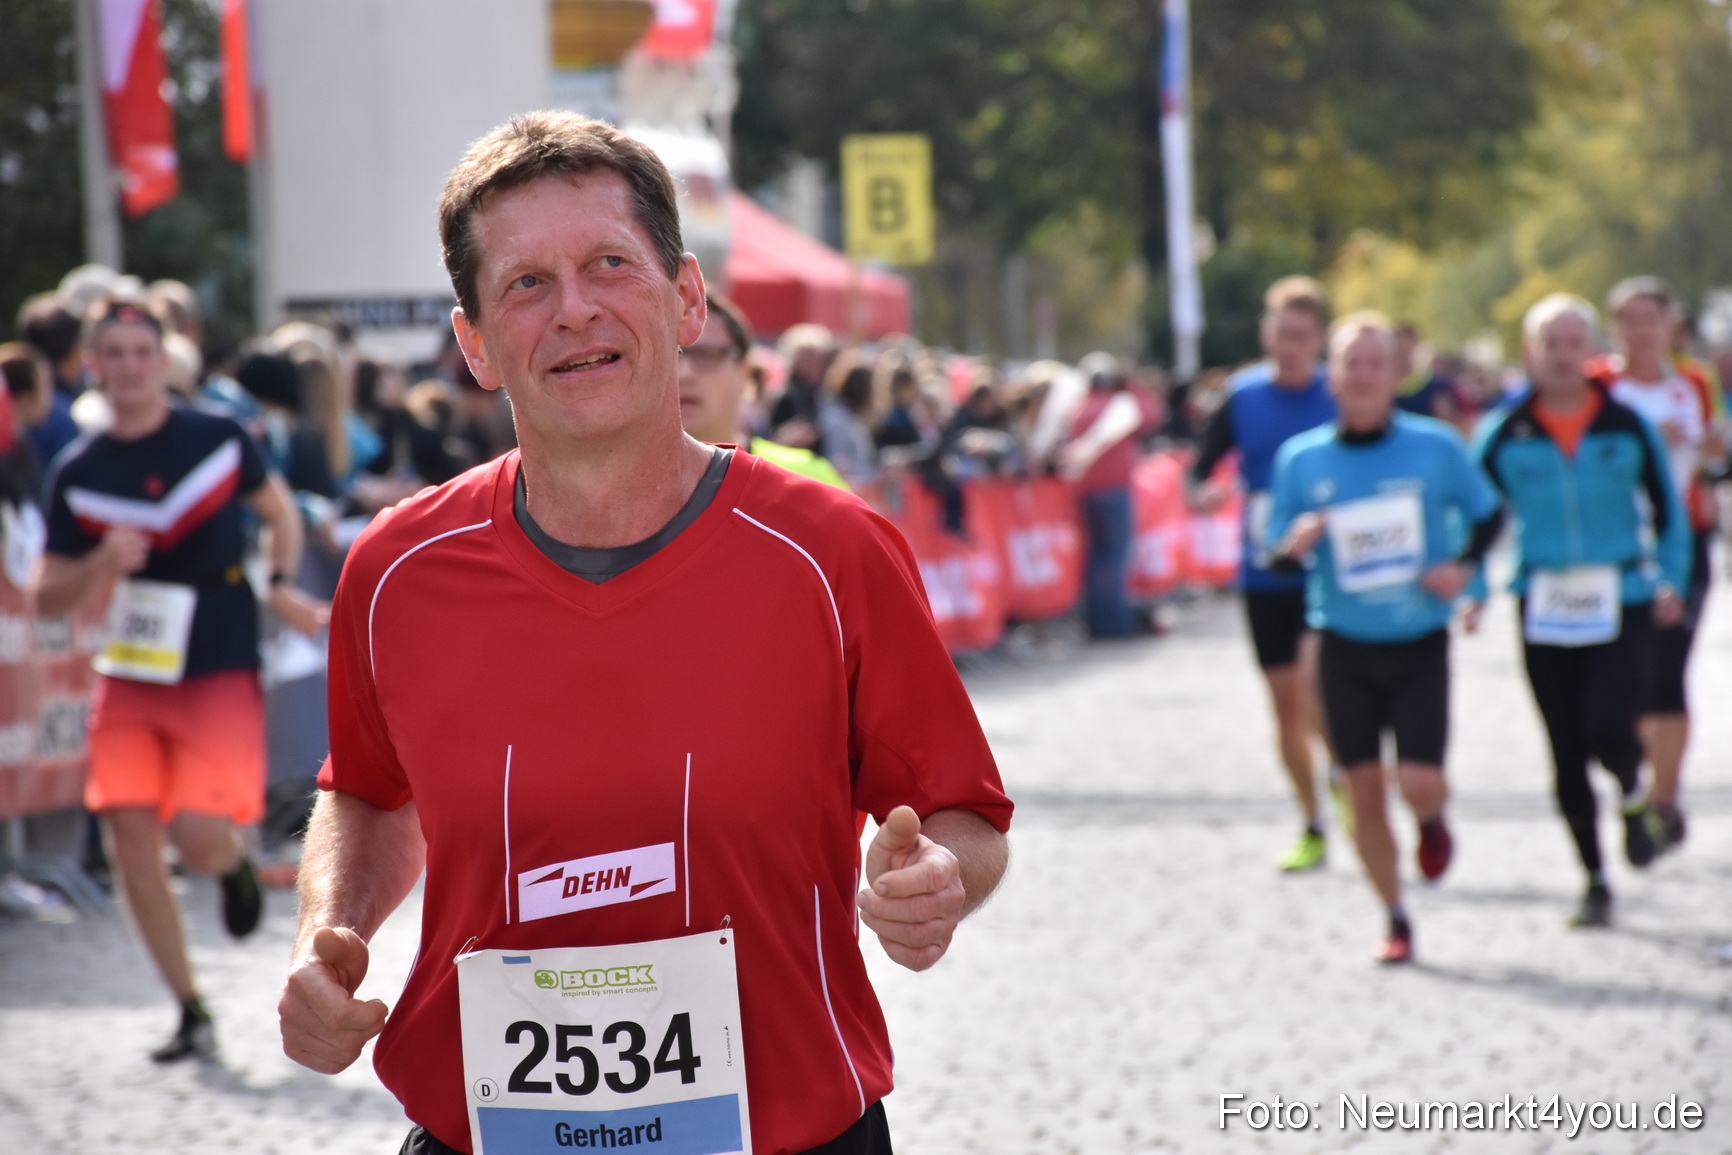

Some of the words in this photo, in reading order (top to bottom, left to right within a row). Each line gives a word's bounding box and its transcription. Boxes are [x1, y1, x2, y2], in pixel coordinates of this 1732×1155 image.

[868, 176, 909, 232] B
[562, 866, 632, 899] DEHN
[561, 965, 656, 990] BOCK
[561, 990, 590, 998] inspired
[592, 989, 601, 997] by
[625, 985, 658, 994] concepts
[505, 1012, 701, 1096] 2534
[481, 1084, 491, 1097] D
[555, 1117, 662, 1148] Gerhard
